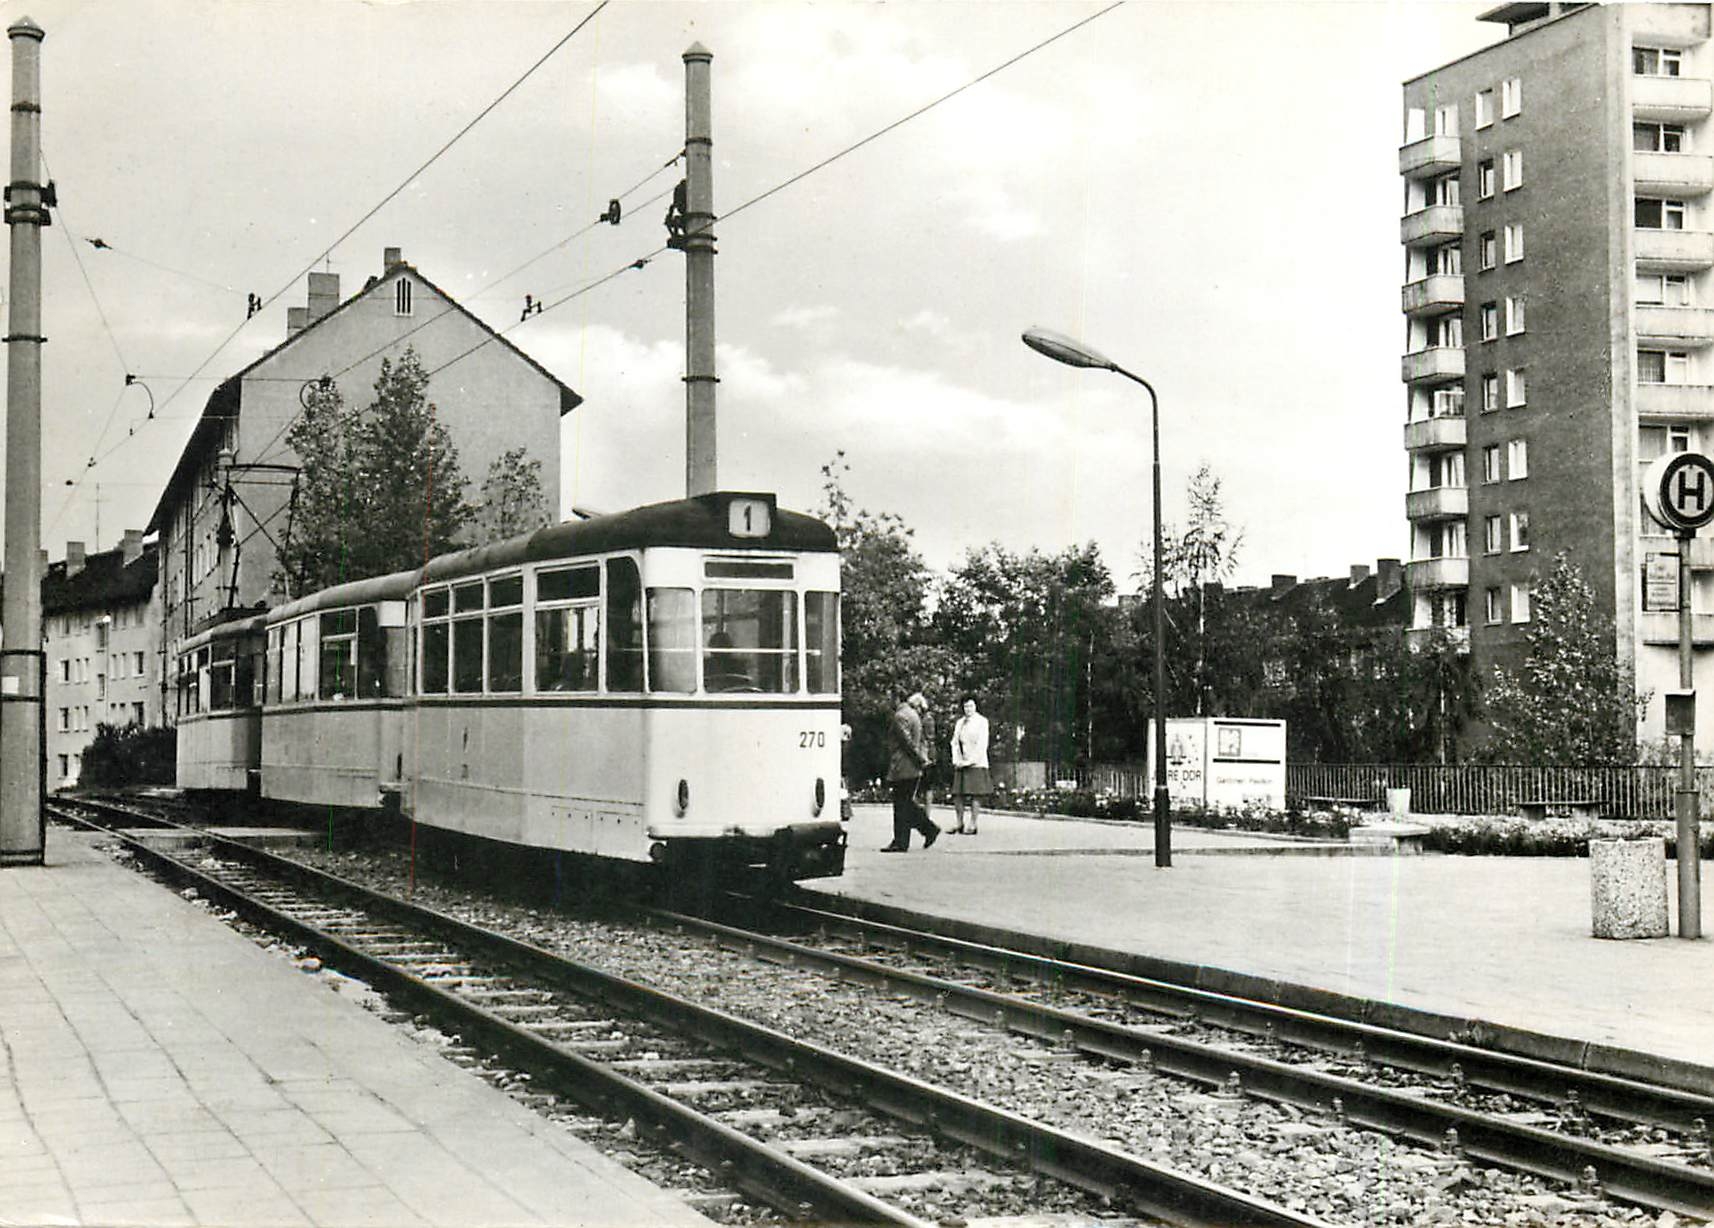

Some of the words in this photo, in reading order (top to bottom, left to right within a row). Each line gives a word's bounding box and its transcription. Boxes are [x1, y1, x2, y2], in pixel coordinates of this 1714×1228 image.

[1677, 471, 1705, 511] H
[744, 504, 752, 532] 1
[799, 731, 825, 748] 270
[1182, 769, 1202, 781] DDR
